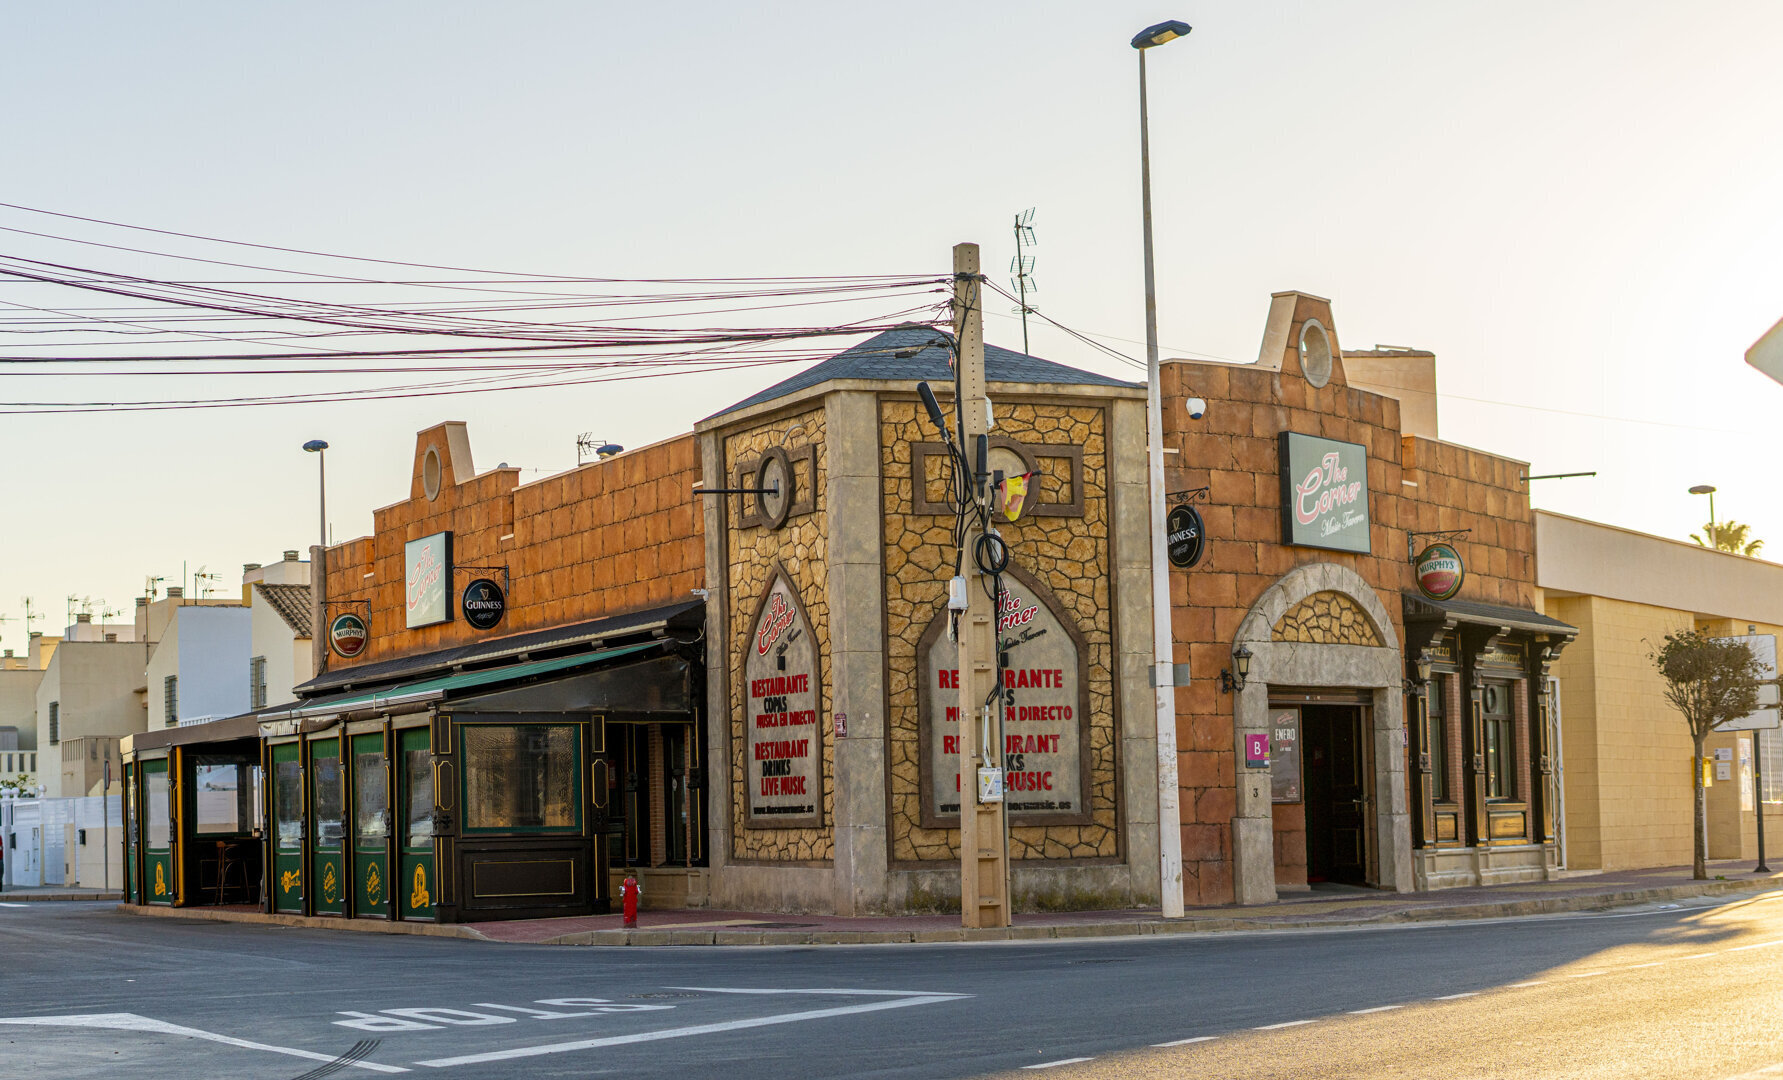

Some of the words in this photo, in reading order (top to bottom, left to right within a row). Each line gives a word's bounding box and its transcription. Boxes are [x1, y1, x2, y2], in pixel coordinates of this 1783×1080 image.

[1321, 452, 1348, 486] The
[1296, 467, 1362, 525] Corner
[408, 561, 442, 611] Corner
[466, 600, 502, 610] GUINNESS
[771, 592, 788, 623] The
[998, 605, 1038, 633] rner
[758, 607, 796, 656] Corner
[752, 674, 808, 698] RESTAURANTE
[763, 696, 787, 713] COPAS
[1019, 705, 1073, 721] DIRECTO
[756, 713, 779, 728] MUSICA
[779, 711, 788, 727] EN
[789, 710, 815, 726] DIRECTO
[1275, 728, 1296, 741] ENERO
[755, 739, 809, 760] RESTAURANT
[1254, 741, 1261, 755] B
[762, 759, 791, 777] DRINKS
[761, 777, 779, 796] LIVE
[780, 776, 806, 795] MUSIC
[1253, 788, 1259, 798] 3
[331, 998, 677, 1032] STOP
